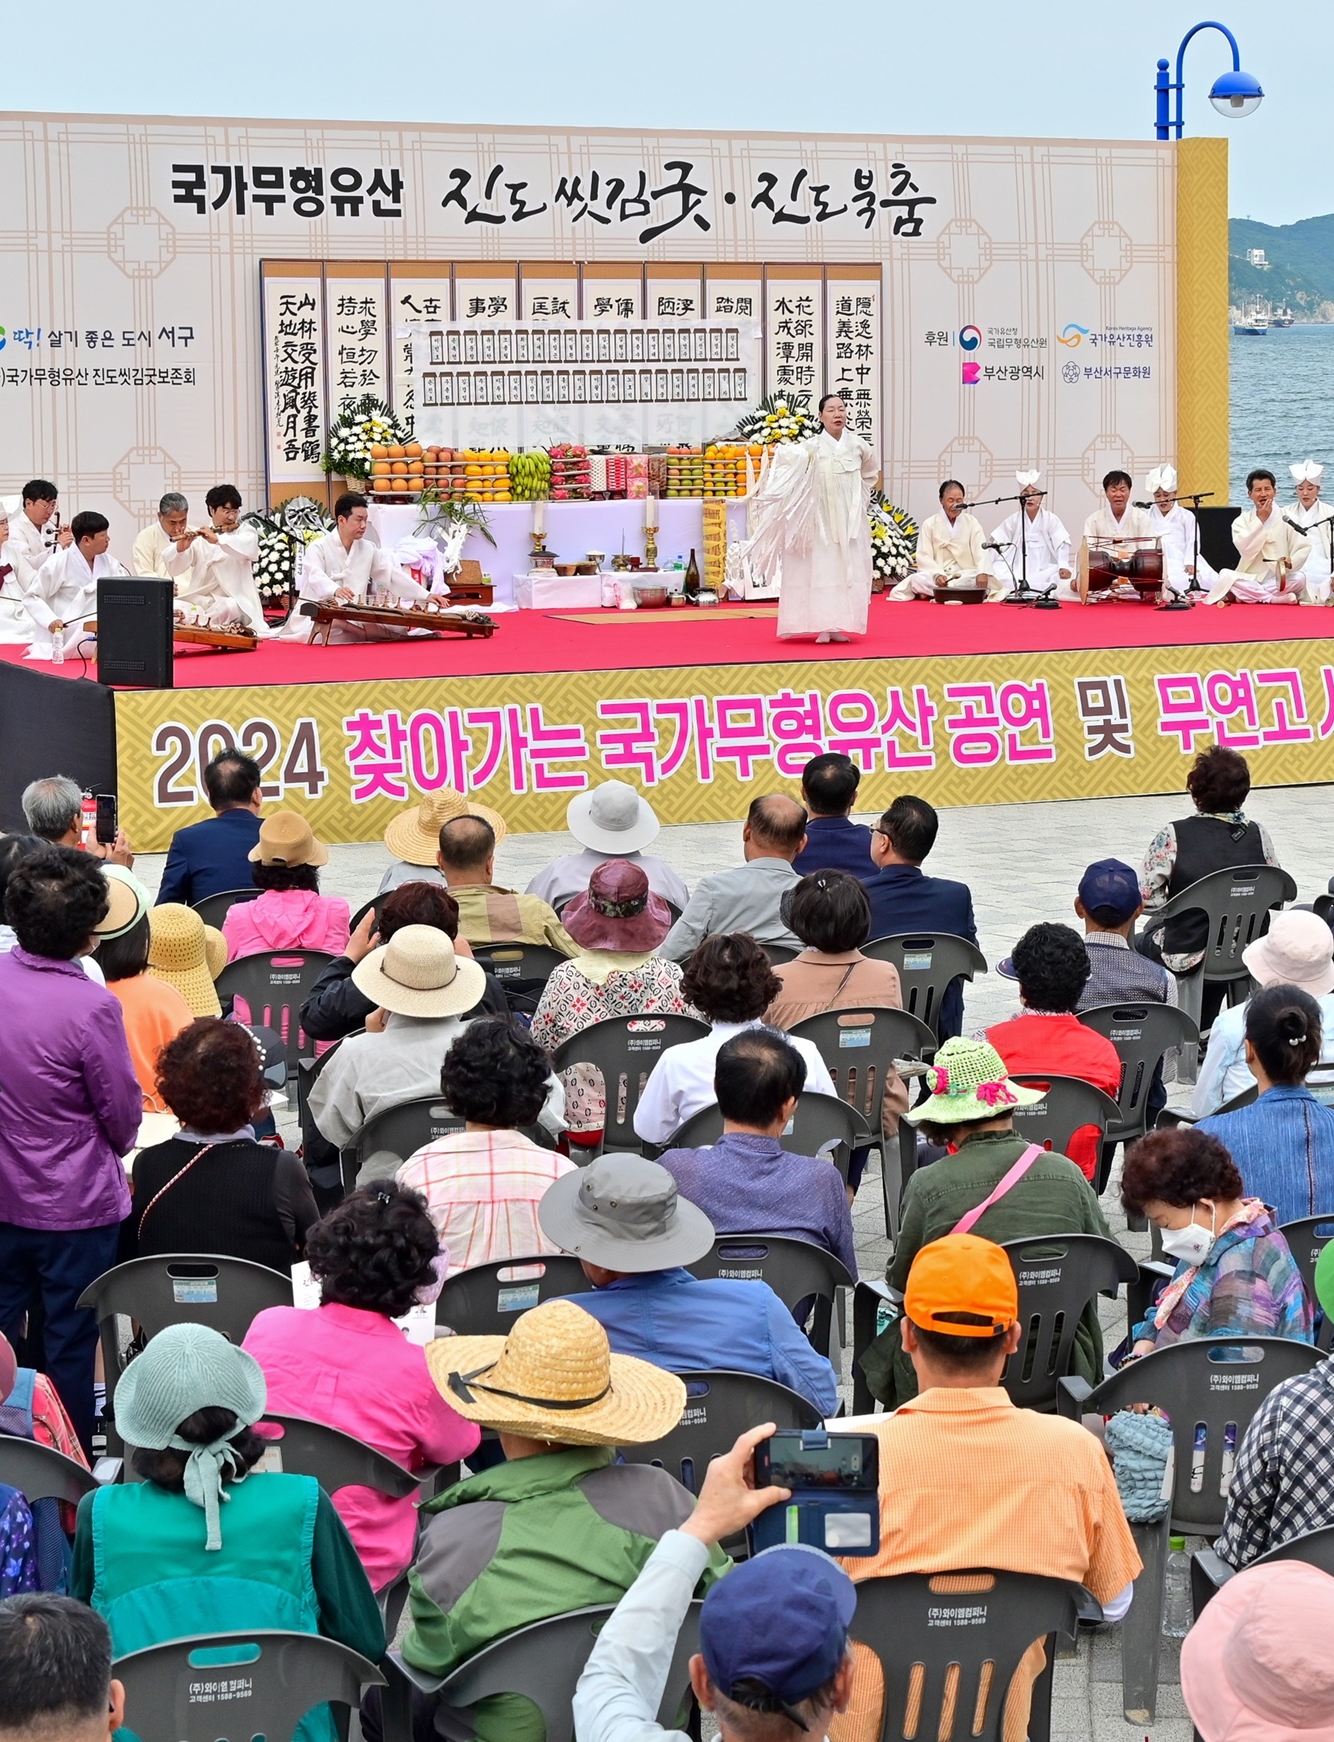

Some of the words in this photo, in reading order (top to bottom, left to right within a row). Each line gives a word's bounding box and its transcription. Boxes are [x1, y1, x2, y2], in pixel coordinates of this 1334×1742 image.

[171, 164, 404, 218] 국가무형유산
[48, 329, 79, 348] 살기
[85, 329, 115, 349] 좋은
[122, 330, 151, 348] 도시
[157, 325, 195, 348] 서구
[924, 331, 949, 347] 후원
[987, 337, 1047, 349] 국립무형유산원
[1089, 333, 1153, 348] 국가유산진흥원
[92, 366, 196, 387] 진도씻김굿보존회
[983, 365, 1044, 381] 부산광역시
[1083, 366, 1151, 379] 부산서구문화원
[155, 720, 324, 804] 2024
[346, 706, 586, 800] 찾아가는
[597, 684, 935, 784] 국가무형유산
[946, 681, 1054, 765] 공연
[1076, 677, 1132, 757] 및
[1157, 668, 1312, 751] 무연고
